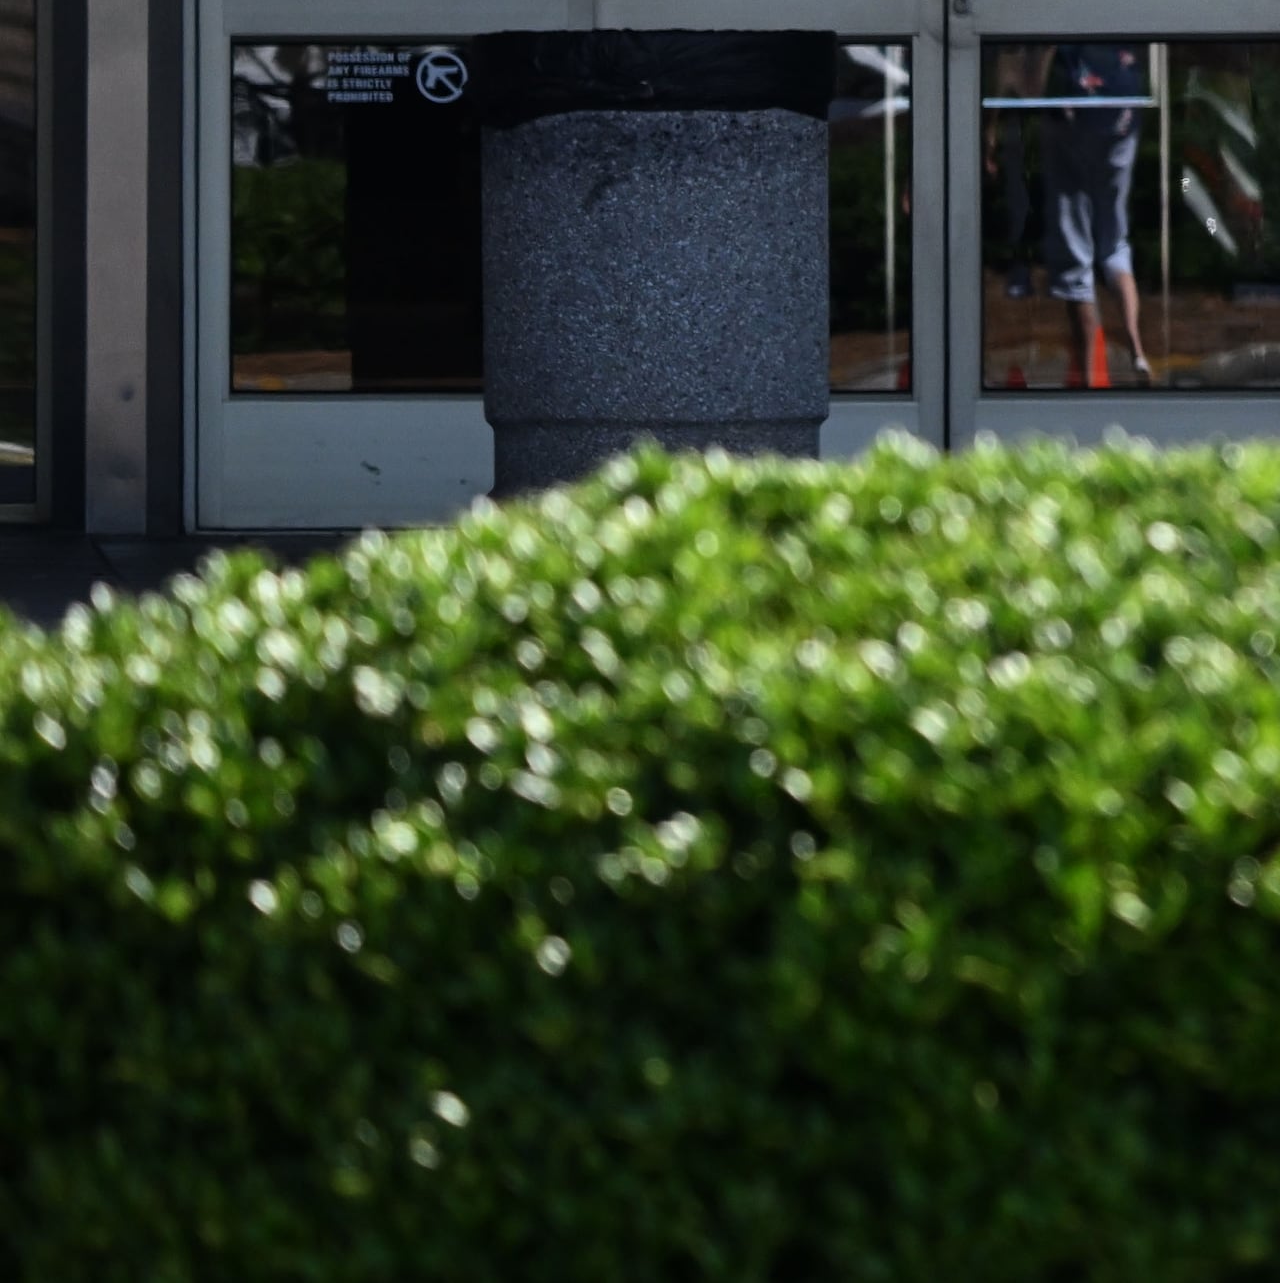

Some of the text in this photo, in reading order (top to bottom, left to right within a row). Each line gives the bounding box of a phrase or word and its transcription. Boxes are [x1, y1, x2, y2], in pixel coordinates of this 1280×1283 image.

[327, 51, 412, 64] POSSESSION OF
[327, 64, 410, 77] ANY FIREARMS
[327, 78, 393, 90] IS STRICTLY
[327, 90, 394, 103] PROHIBITED
